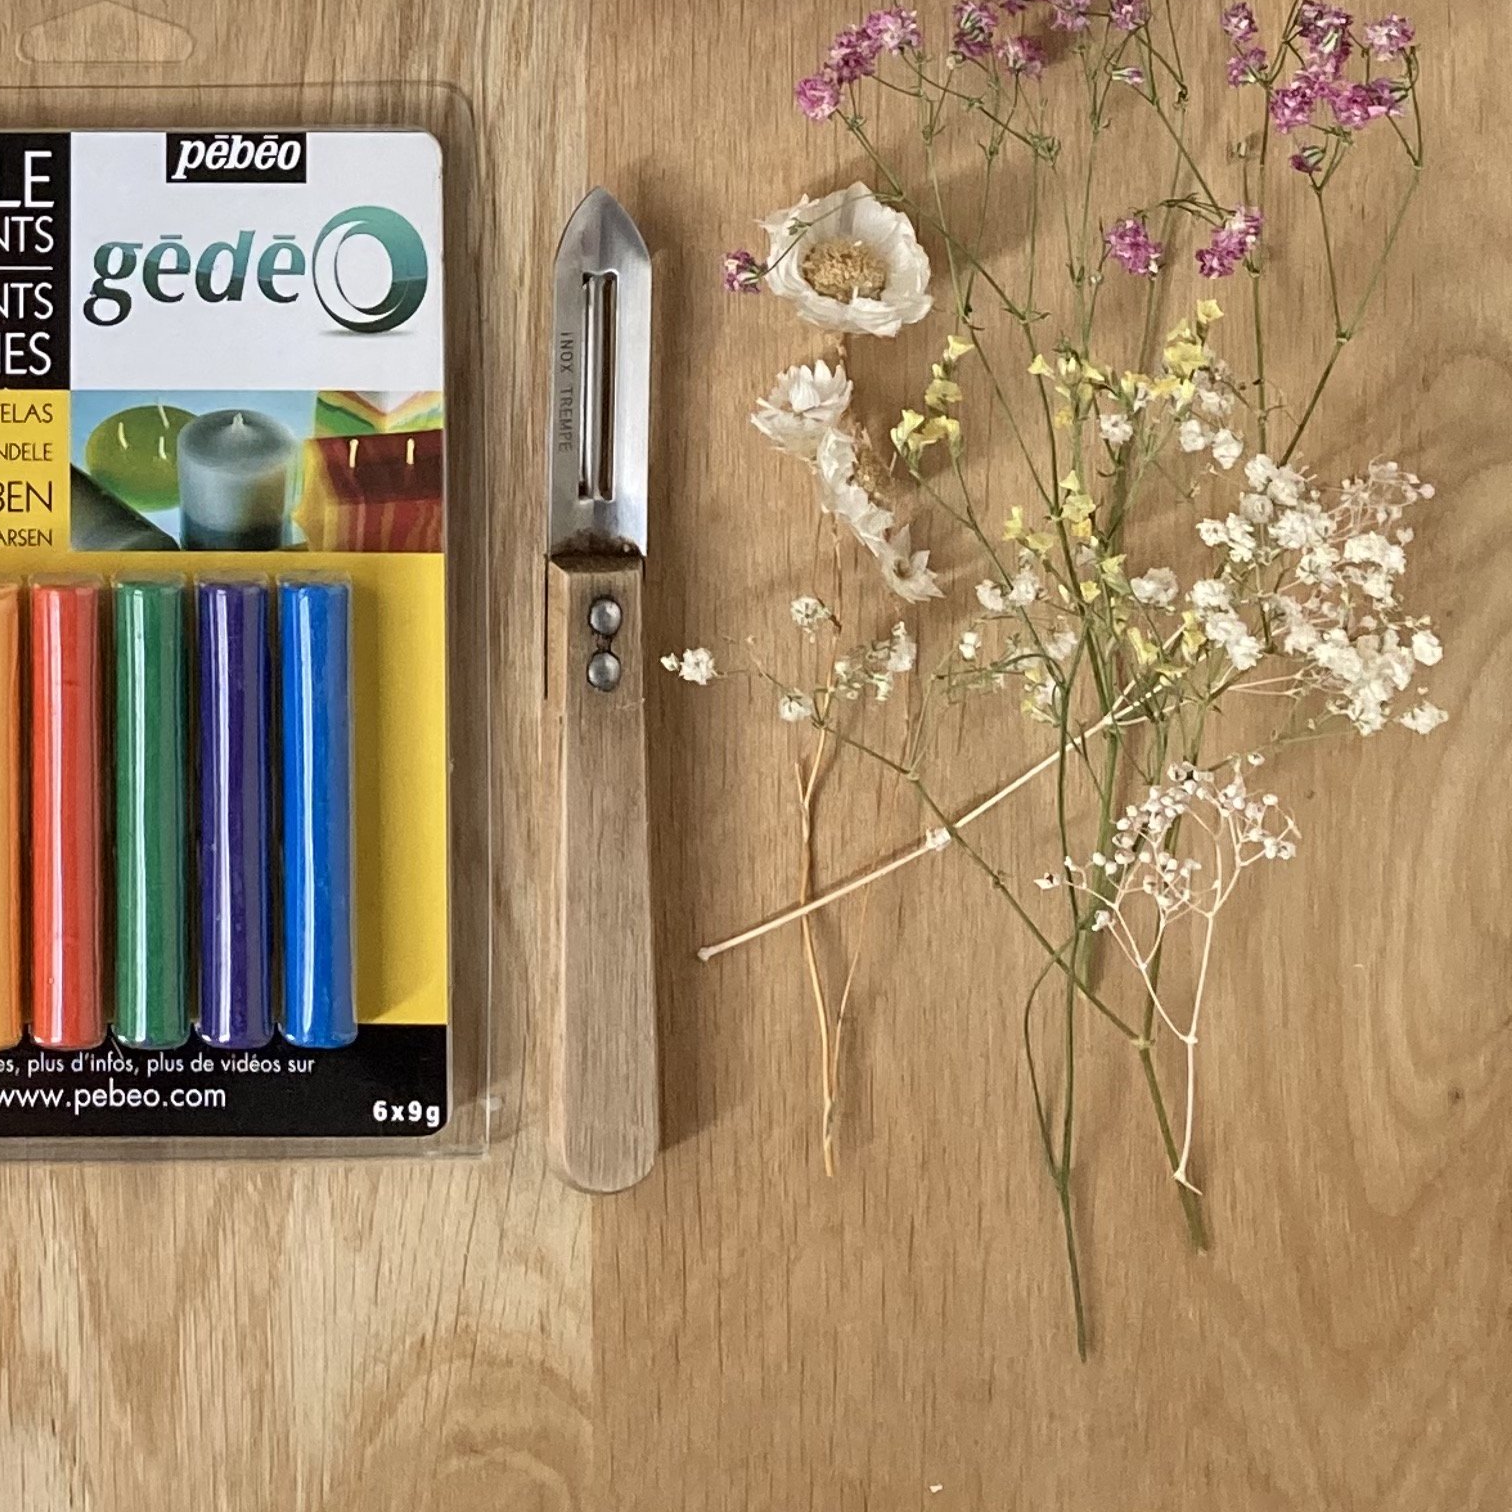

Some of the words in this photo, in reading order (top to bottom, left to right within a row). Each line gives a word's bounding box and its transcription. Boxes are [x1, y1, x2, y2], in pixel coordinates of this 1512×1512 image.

[559, 331, 575, 374] INOX
[27, 1051, 65, 1079] plus
[147, 1051, 185, 1078] plus
[190, 1051, 215, 1073] de
[220, 1051, 282, 1073] vidéos
[287, 1058, 316, 1074] sur
